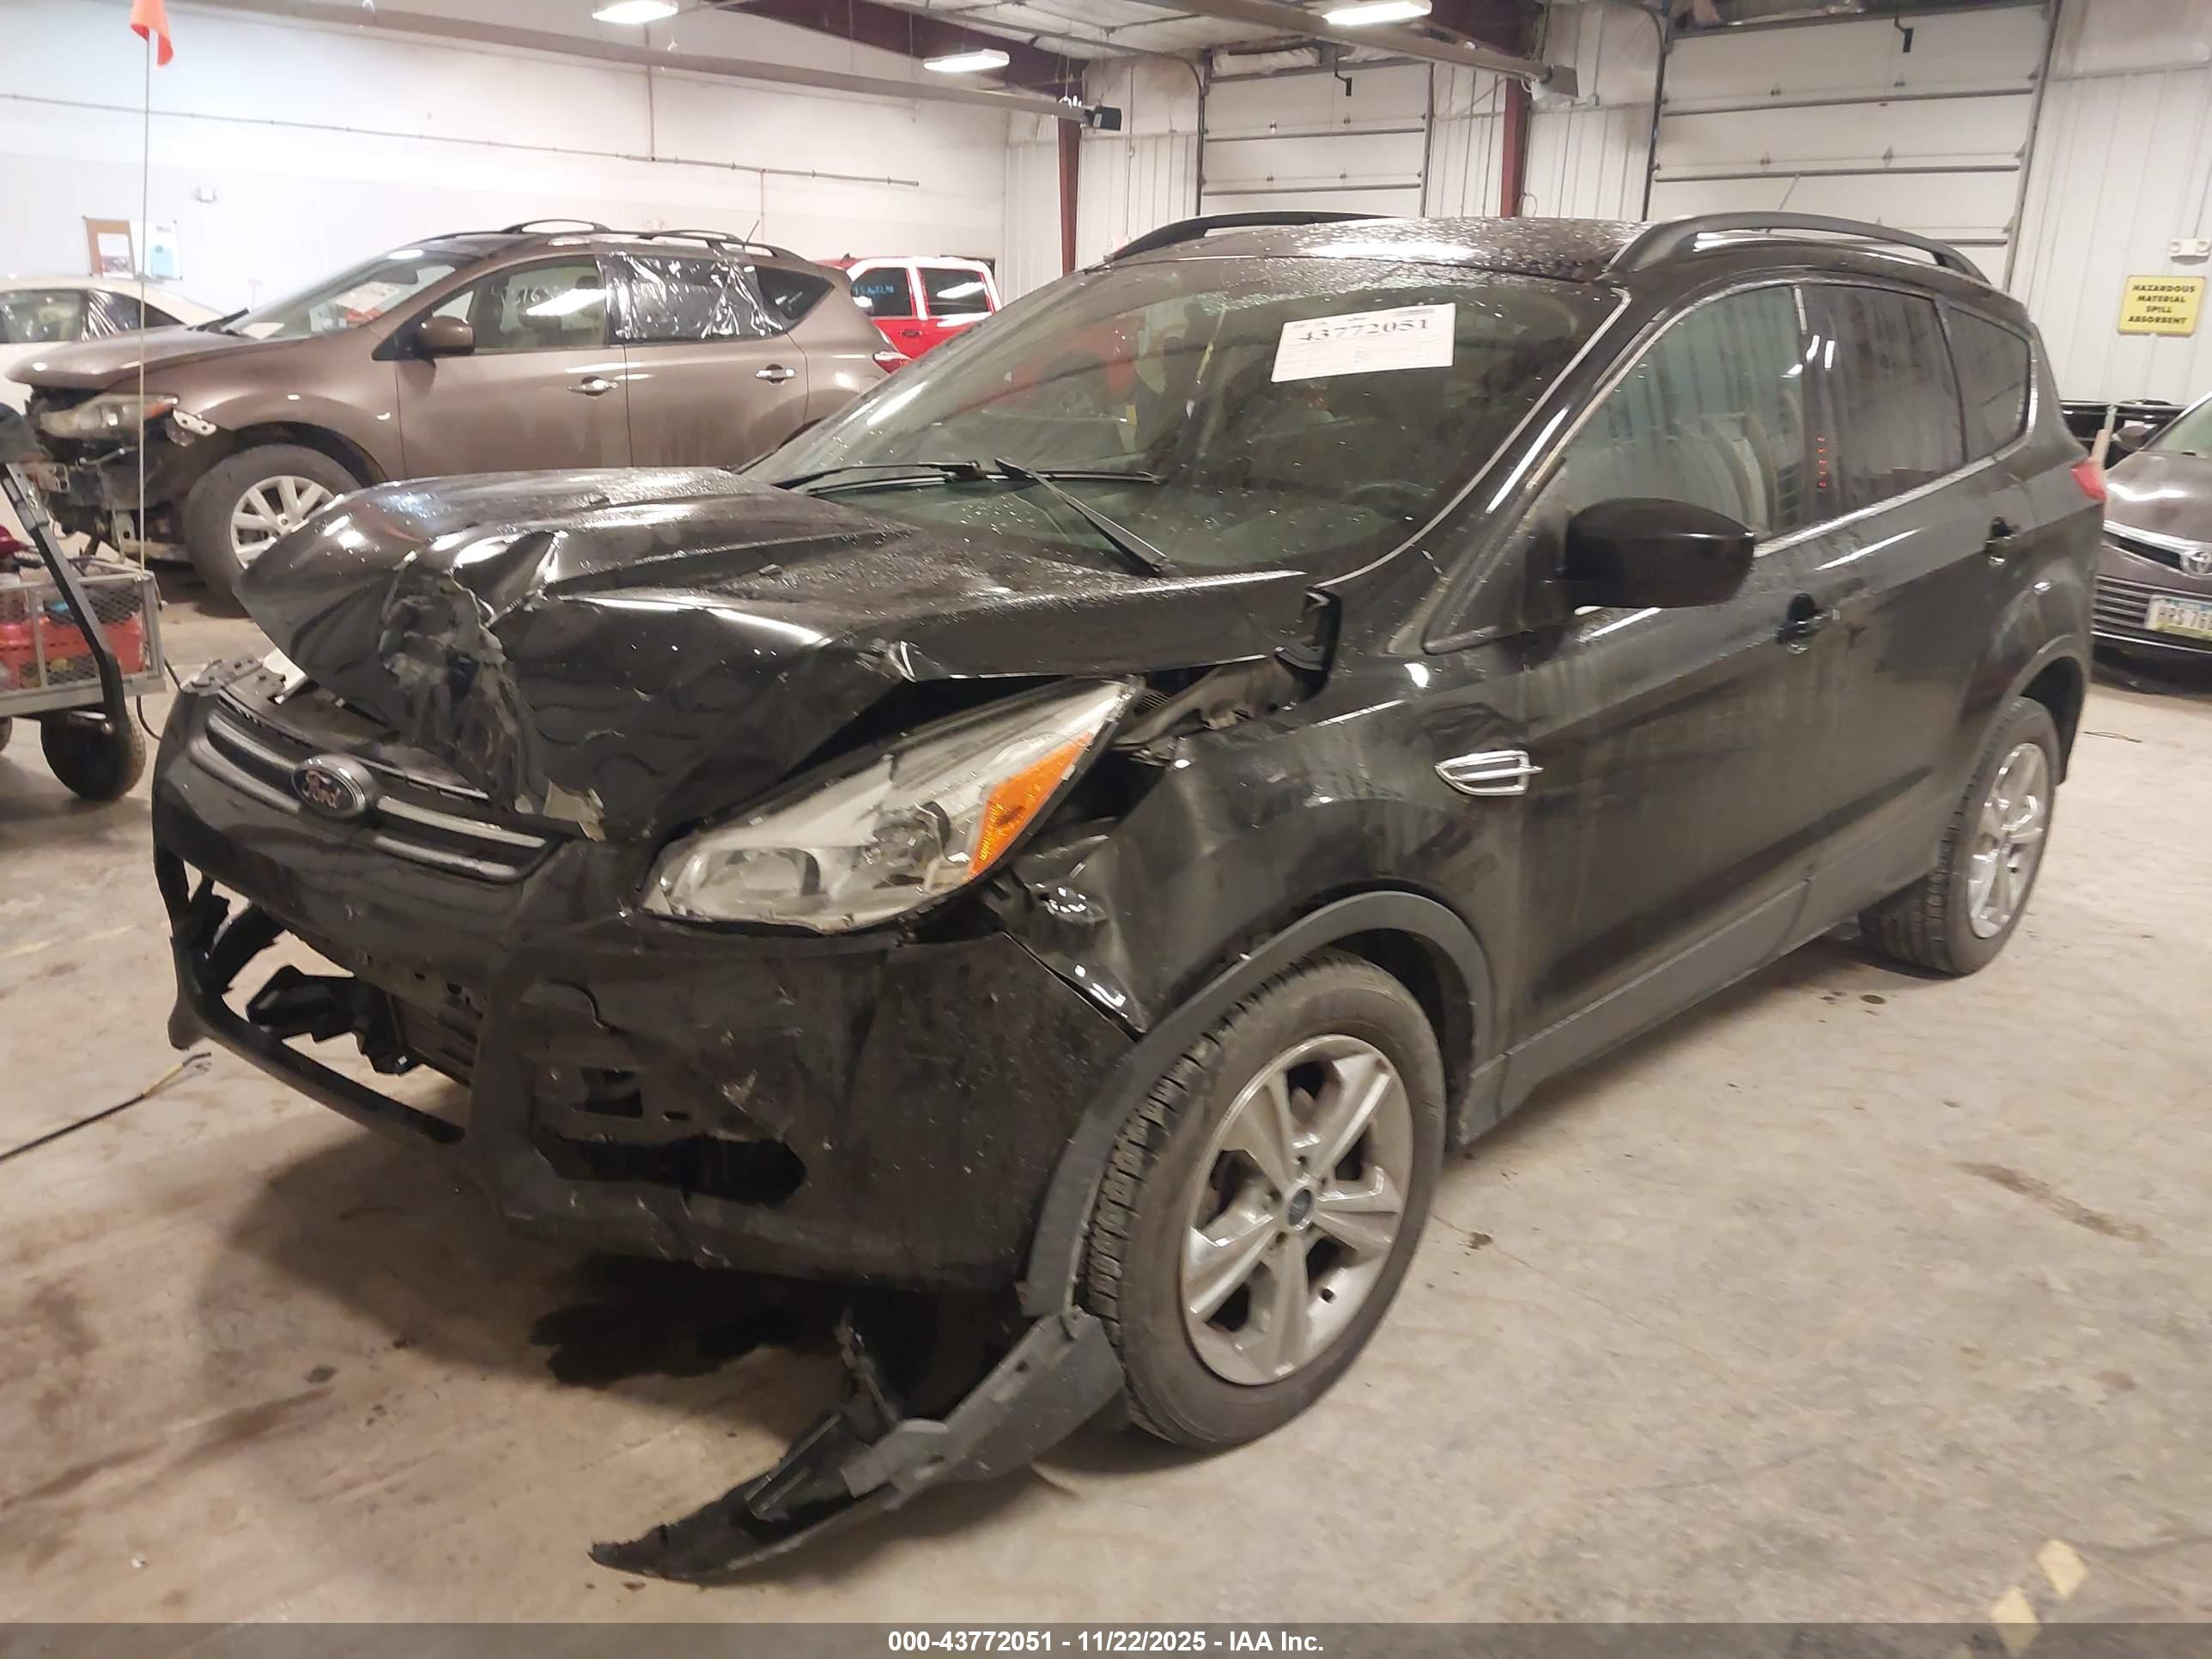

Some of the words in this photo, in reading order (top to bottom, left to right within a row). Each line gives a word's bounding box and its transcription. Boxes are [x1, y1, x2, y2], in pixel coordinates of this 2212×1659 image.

[2132, 284, 2196, 293] HAZARDOUS
[2136, 295, 2187, 303] MATERIAL
[2145, 305, 2172, 313] SPILL
[2127, 315, 2188, 325] ABSORBENT
